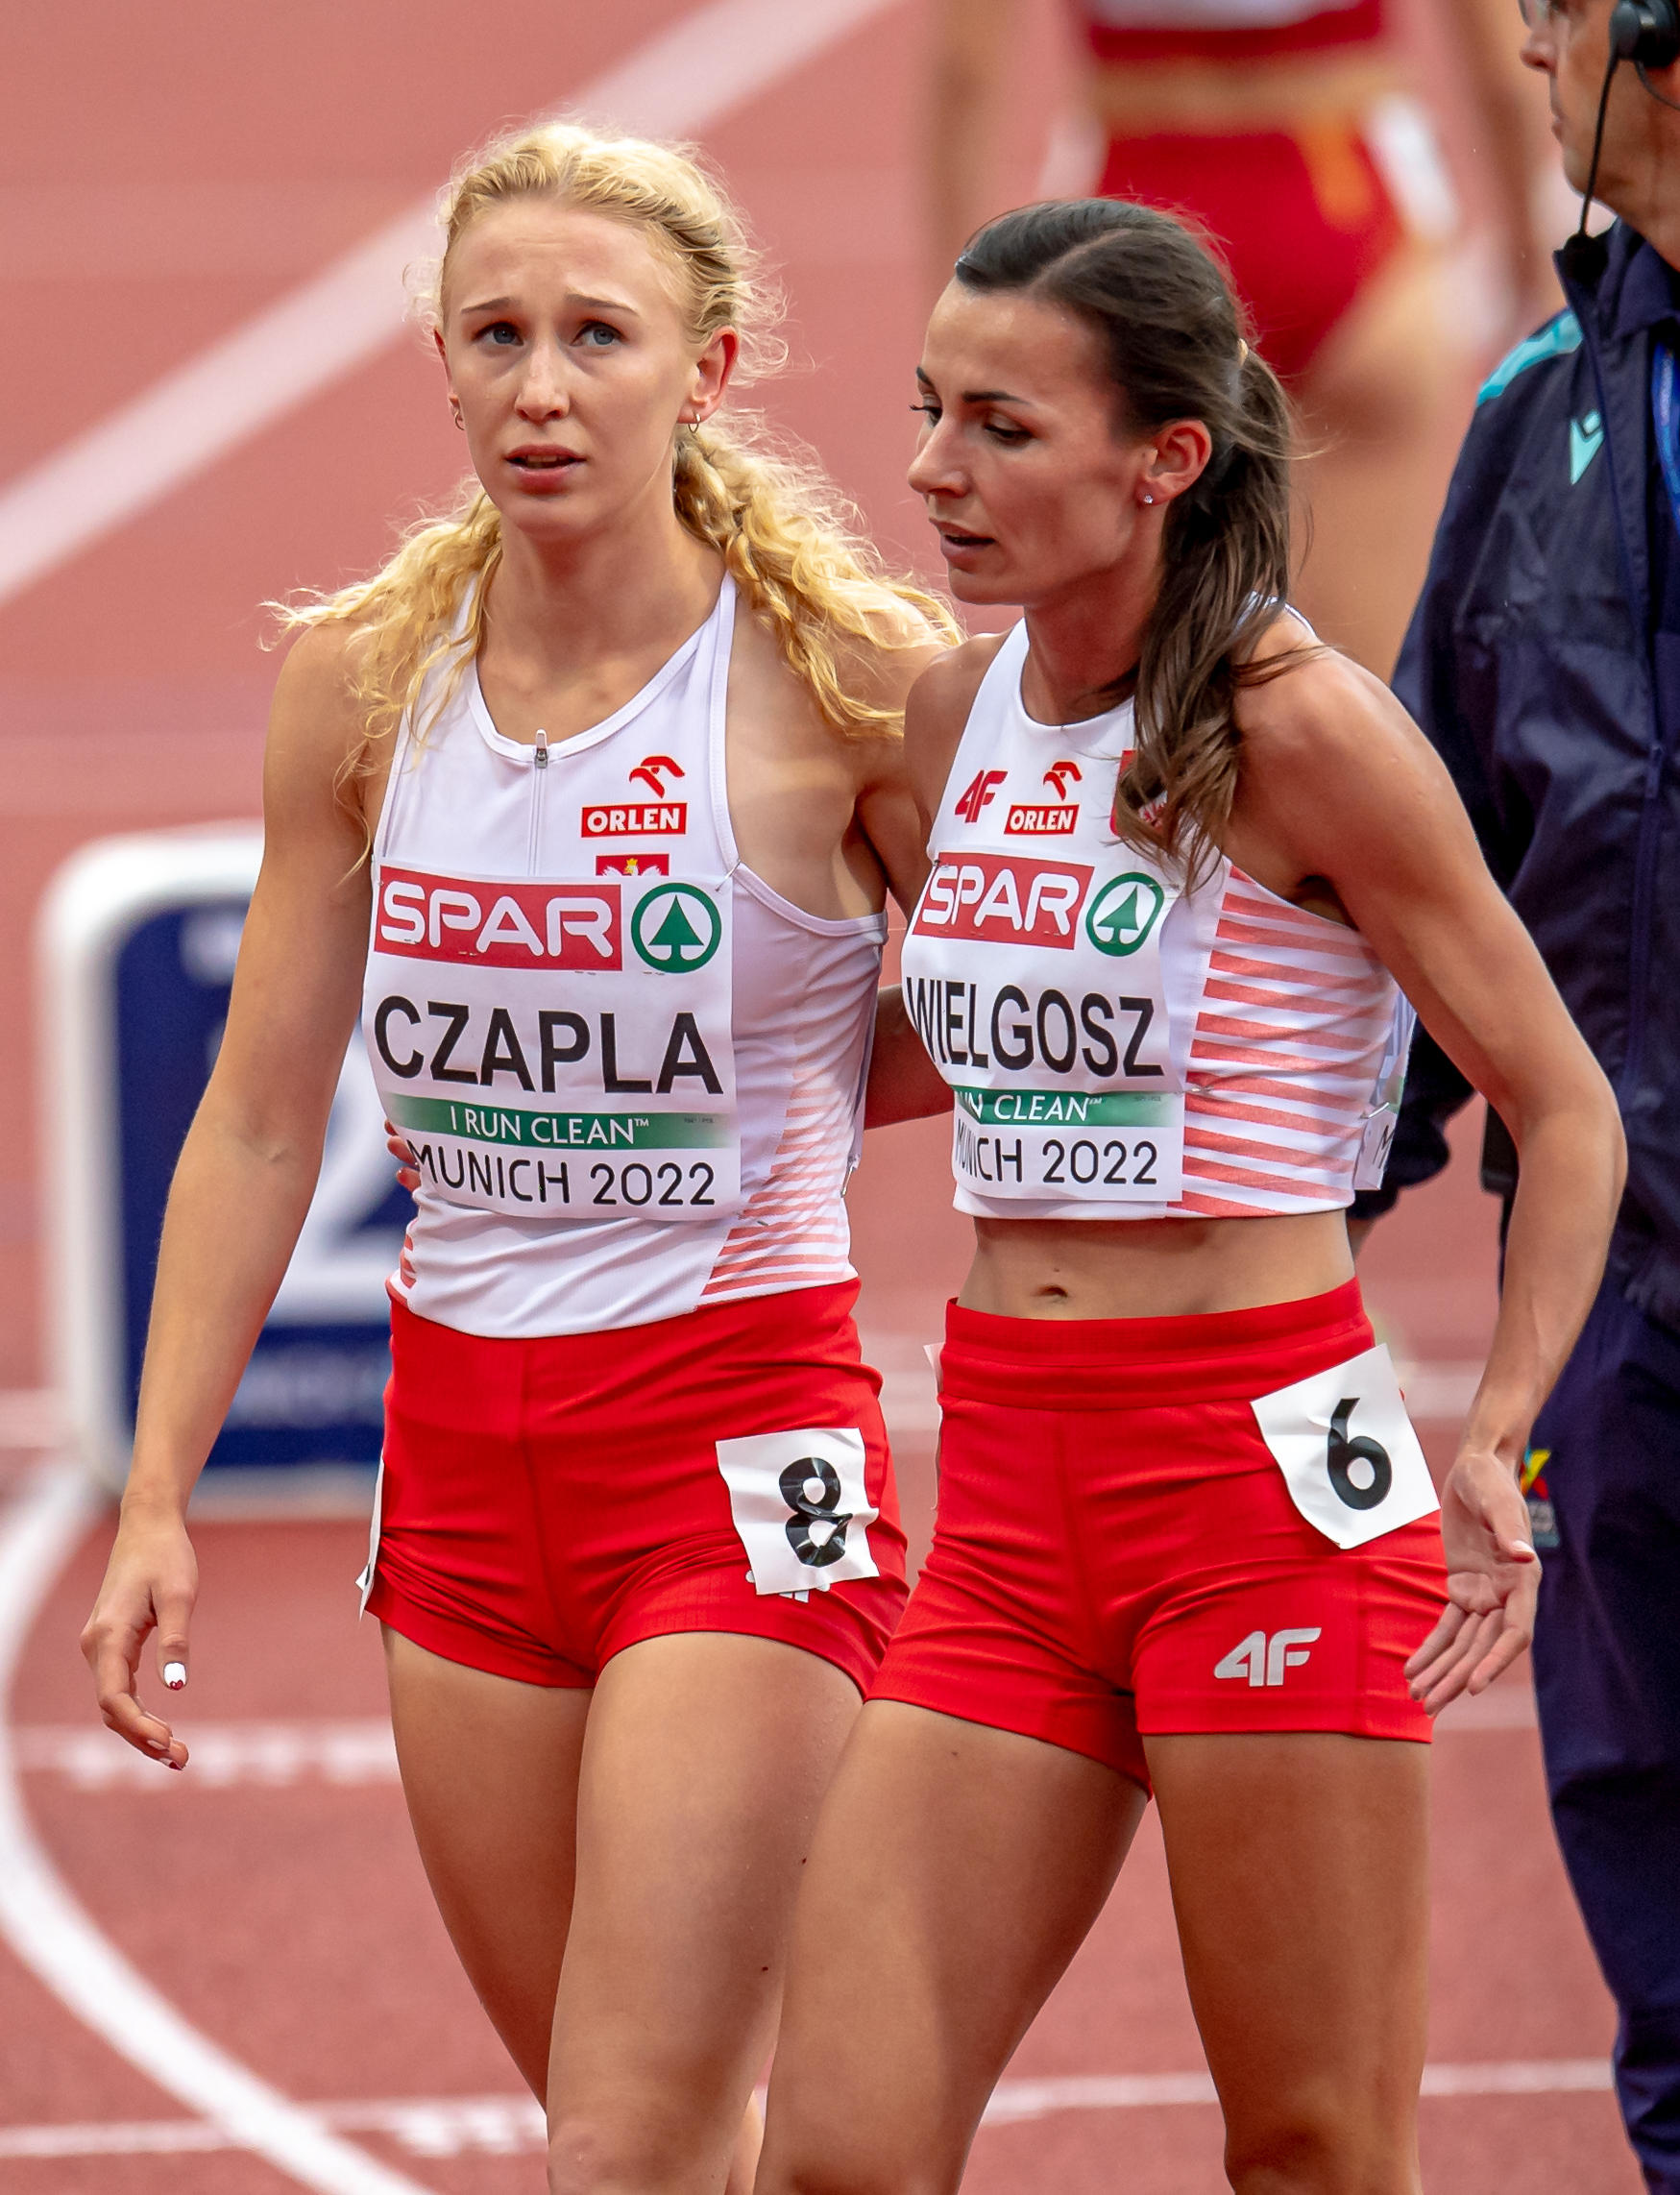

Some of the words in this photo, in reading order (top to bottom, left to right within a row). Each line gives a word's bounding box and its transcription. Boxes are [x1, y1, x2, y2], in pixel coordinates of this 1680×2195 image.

[586, 807, 681, 833] ORLEN
[955, 769, 1008, 823] 4F
[1010, 809, 1074, 832] ORLEN
[380, 880, 614, 959] SPAR
[921, 865, 1080, 936] SPAR
[374, 995, 724, 1095] CZAPLA
[906, 976, 1164, 1077] WIELGOSZ
[450, 1106, 457, 1130] I
[465, 1114, 522, 1140] RUN
[406, 1138, 571, 1204] MUNICH
[590, 1162, 716, 1206] 2022
[1042, 1139, 1157, 1184] 2022
[1327, 1397, 1392, 1510] 6
[779, 1457, 854, 1568] 8
[1213, 1627, 1322, 1688] 4F
